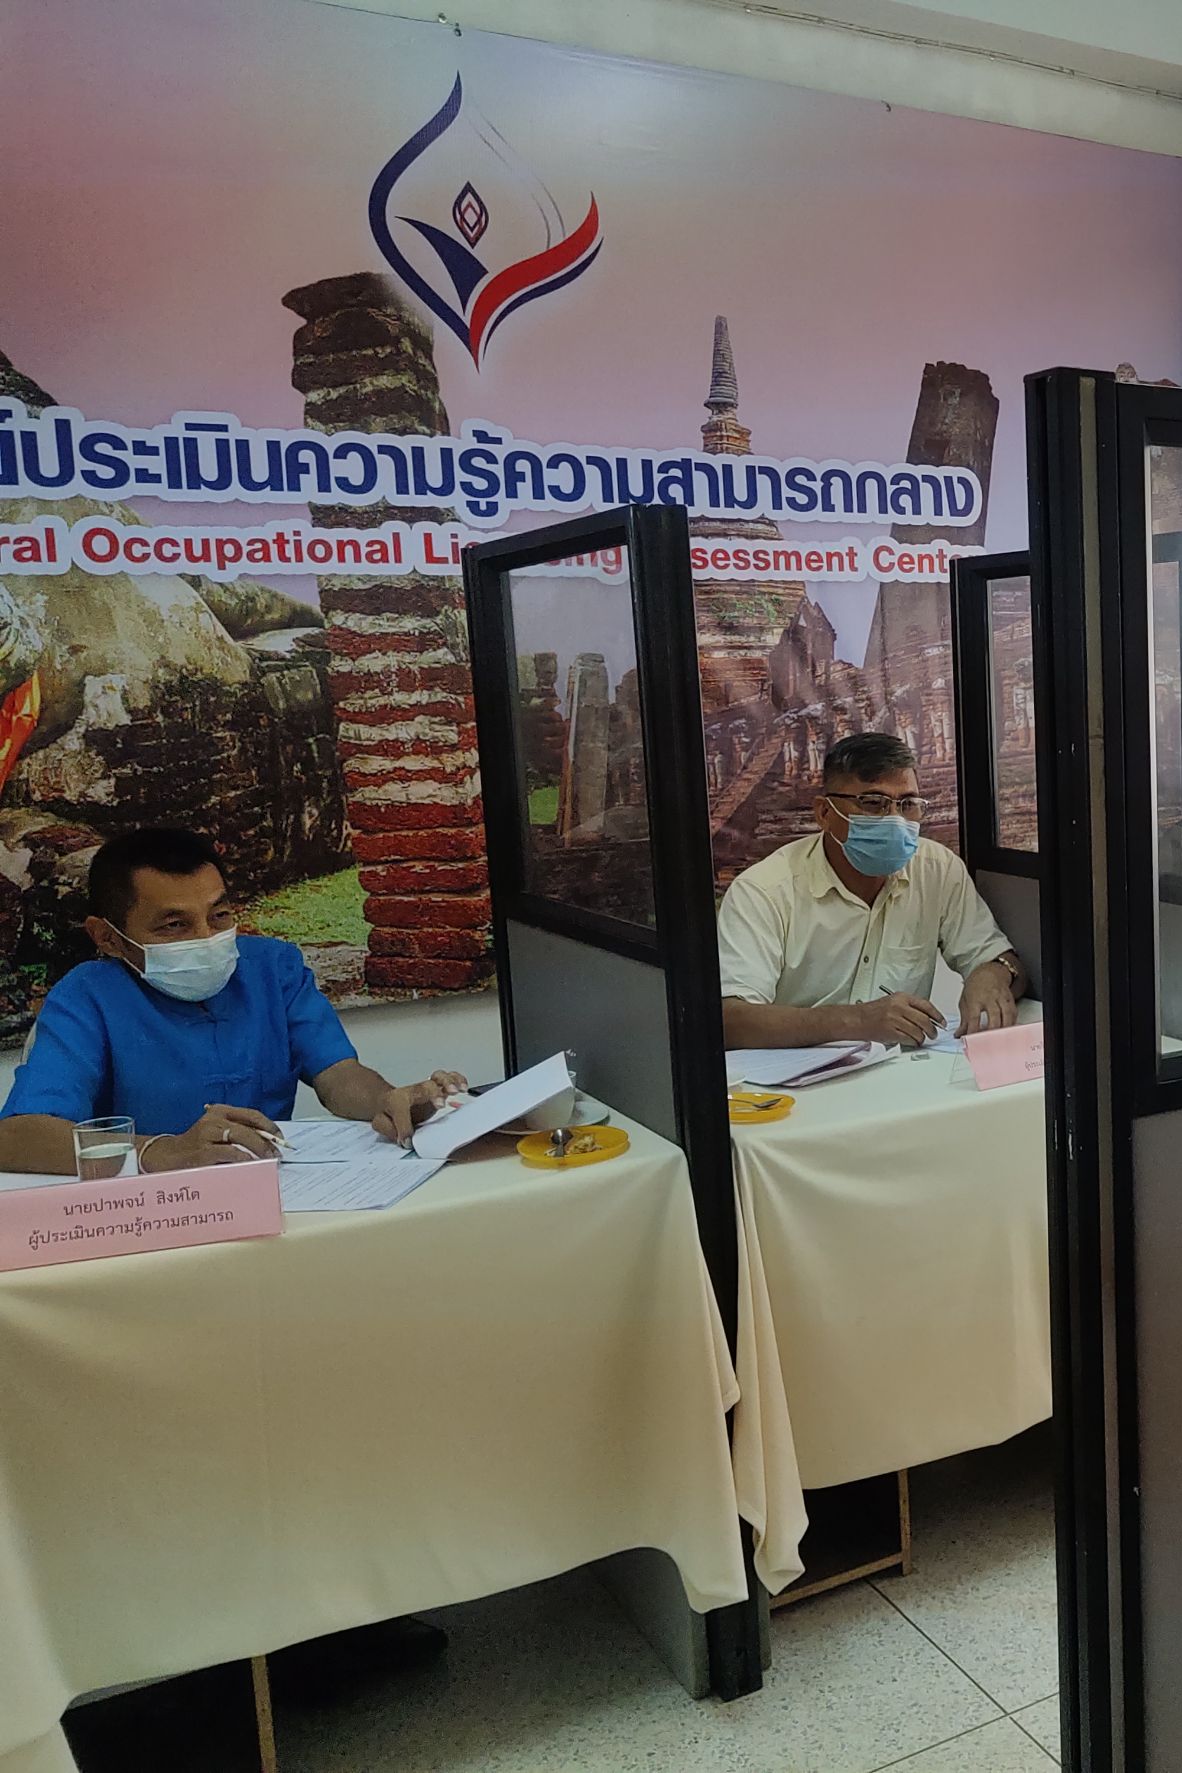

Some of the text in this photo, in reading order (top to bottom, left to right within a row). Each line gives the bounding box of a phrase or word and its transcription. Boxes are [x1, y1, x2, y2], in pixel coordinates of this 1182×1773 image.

[81, 527, 403, 570] Occupational
[28, 1210, 234, 1250] ผู้ประเมินความรู้ความสามารถ
